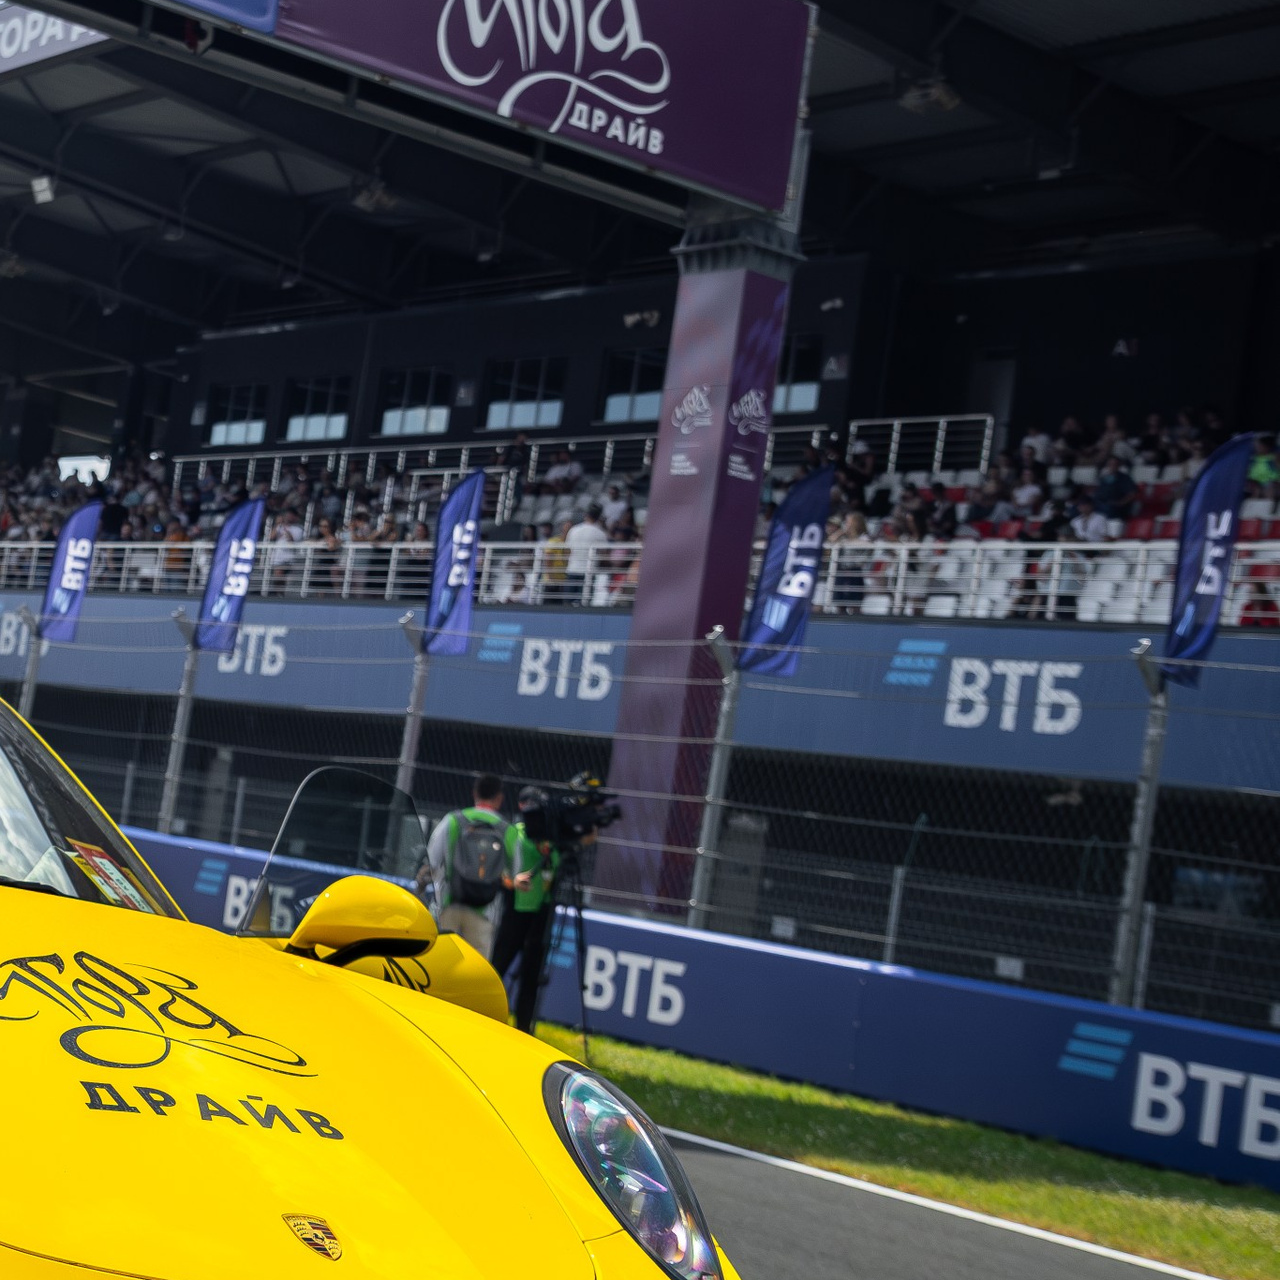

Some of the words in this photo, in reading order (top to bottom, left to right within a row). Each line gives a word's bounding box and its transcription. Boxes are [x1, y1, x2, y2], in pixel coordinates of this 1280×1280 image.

[568, 101, 665, 155] ДРАЙВ
[61, 537, 93, 591] ВТБ
[776, 522, 823, 598] ВТБ
[517, 637, 614, 701] ВТБ
[942, 656, 1083, 735] ВТБ
[223, 874, 296, 933] ВБ
[582, 944, 687, 1026] ВТБ
[80, 1080, 344, 1140] ДРАЙВ
[1131, 1051, 1280, 1161] ВТБ
